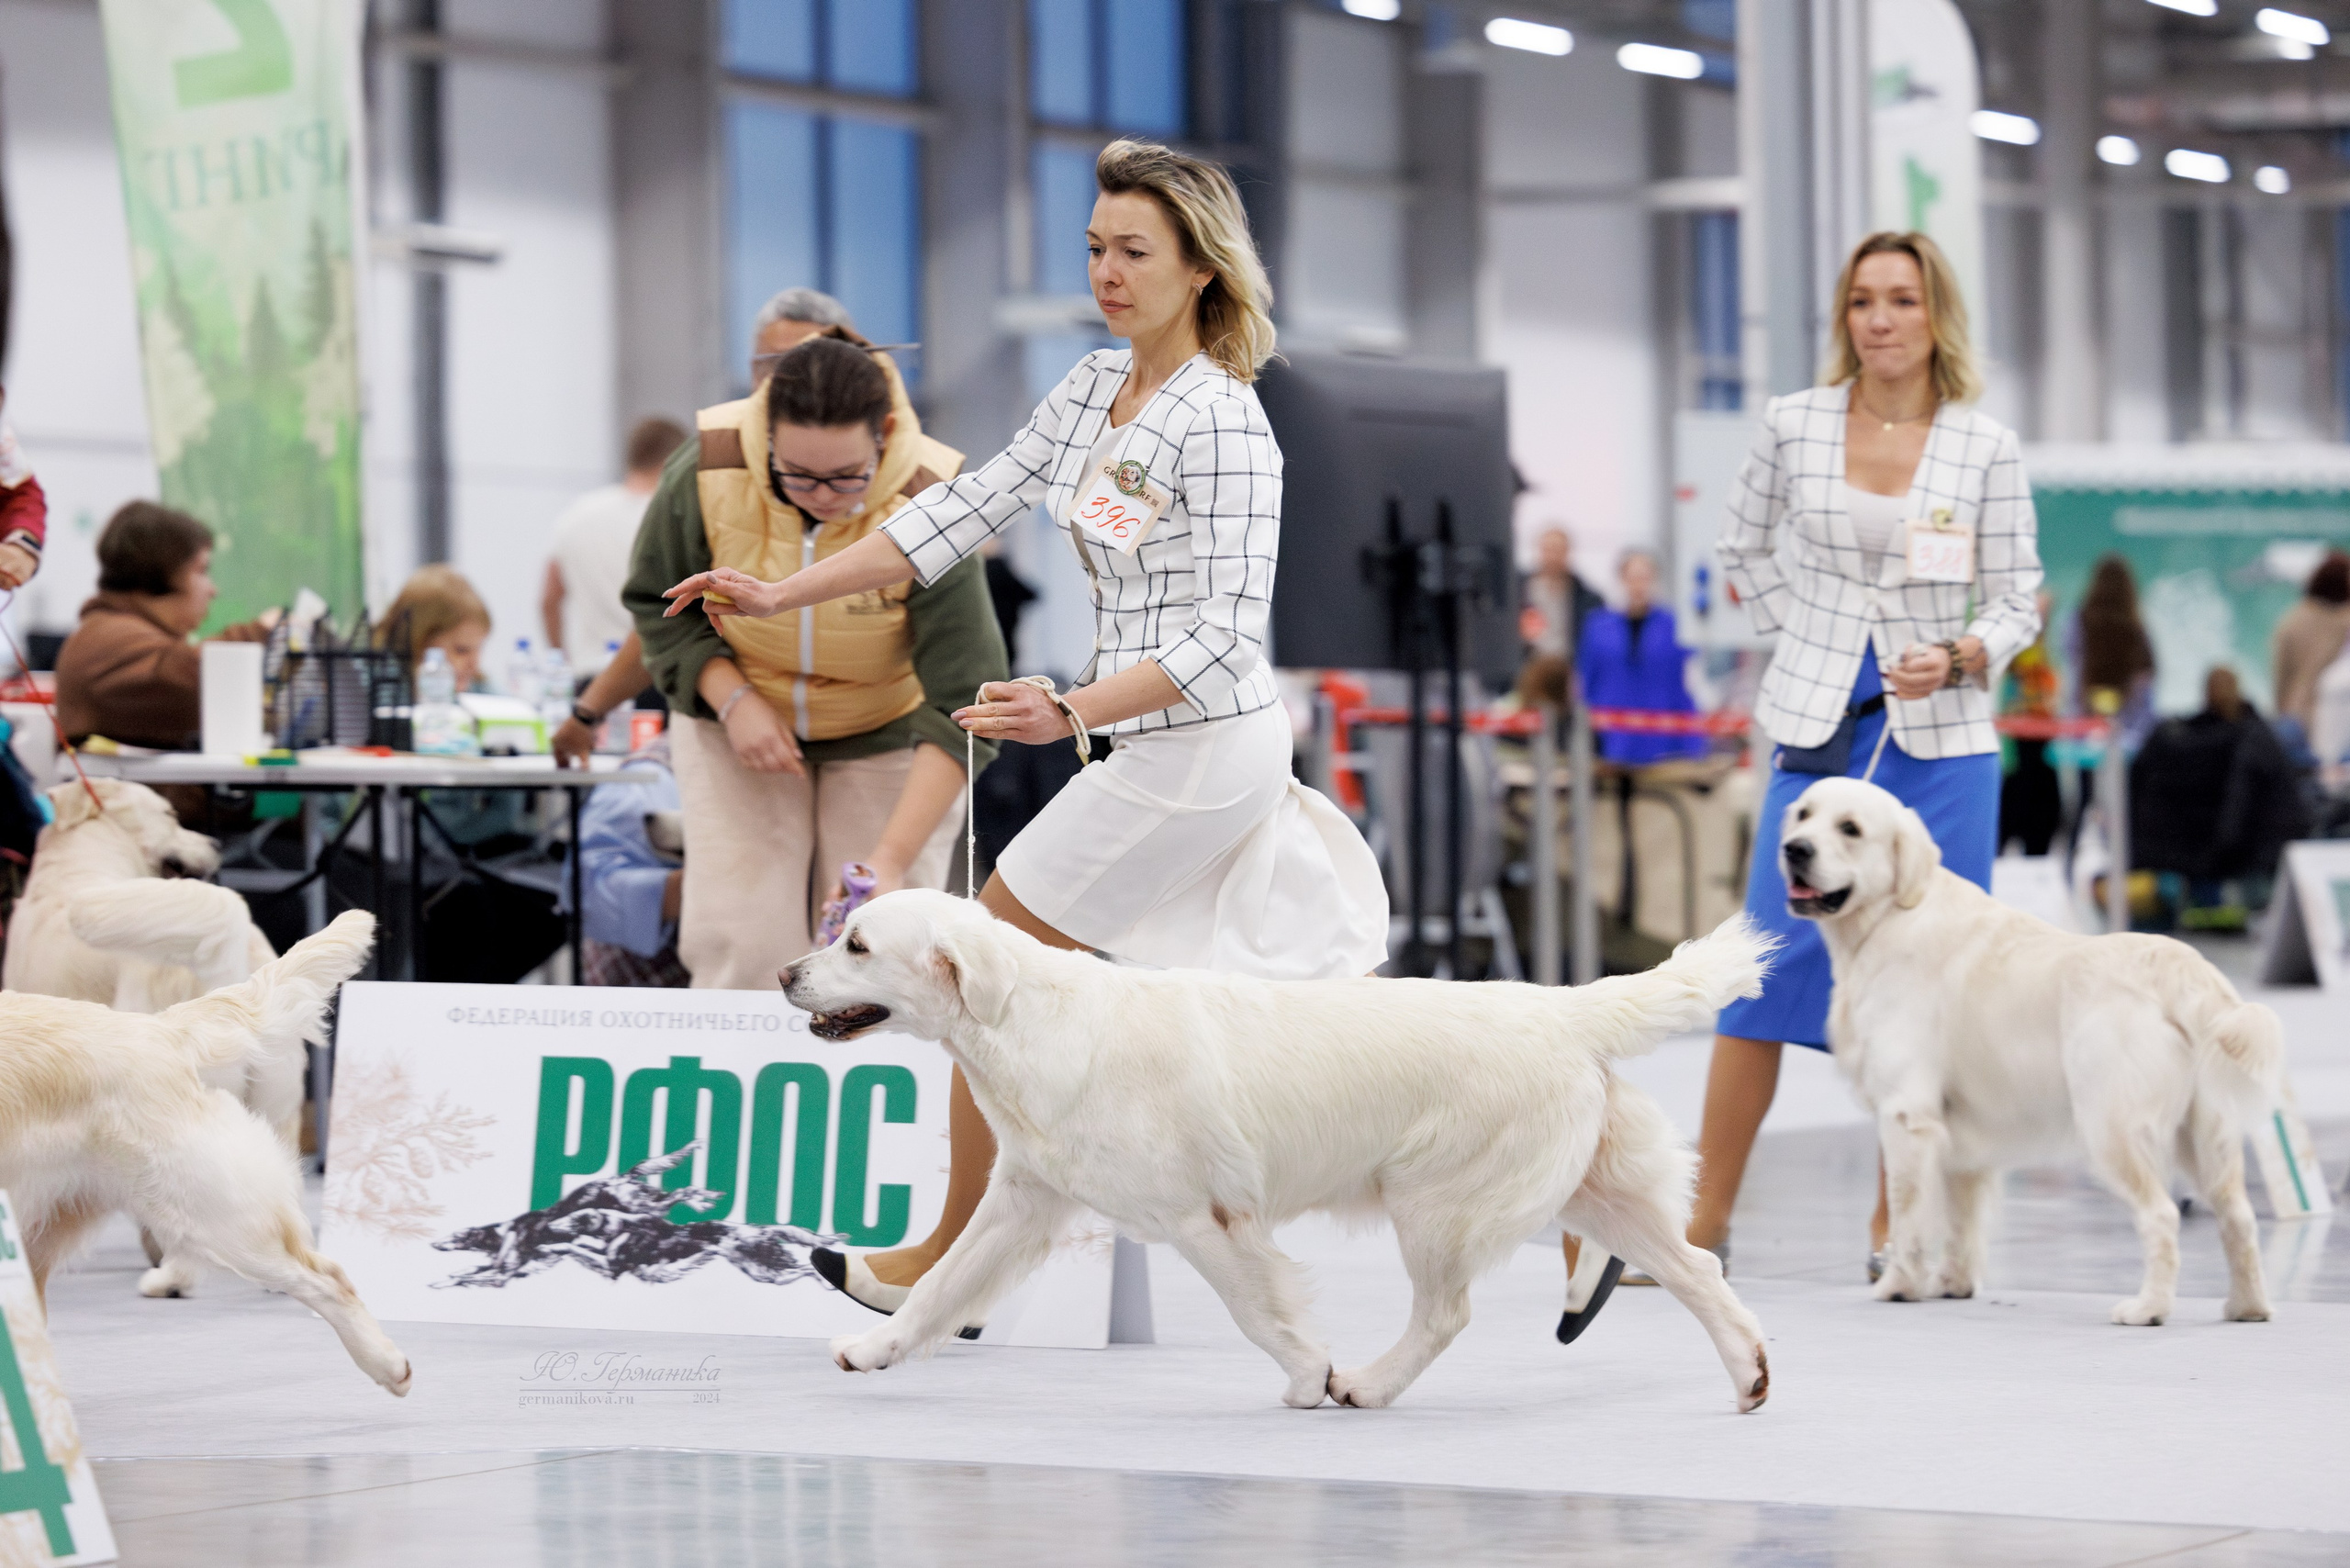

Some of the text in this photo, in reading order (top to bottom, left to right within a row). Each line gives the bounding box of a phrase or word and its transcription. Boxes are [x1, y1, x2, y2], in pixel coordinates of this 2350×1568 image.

[1080, 497, 1141, 539] 396
[446, 1006, 593, 1027] ФЕДЕРАЦИЯ
[599, 1010, 781, 1033] ОХОТНИЧЬЕГО
